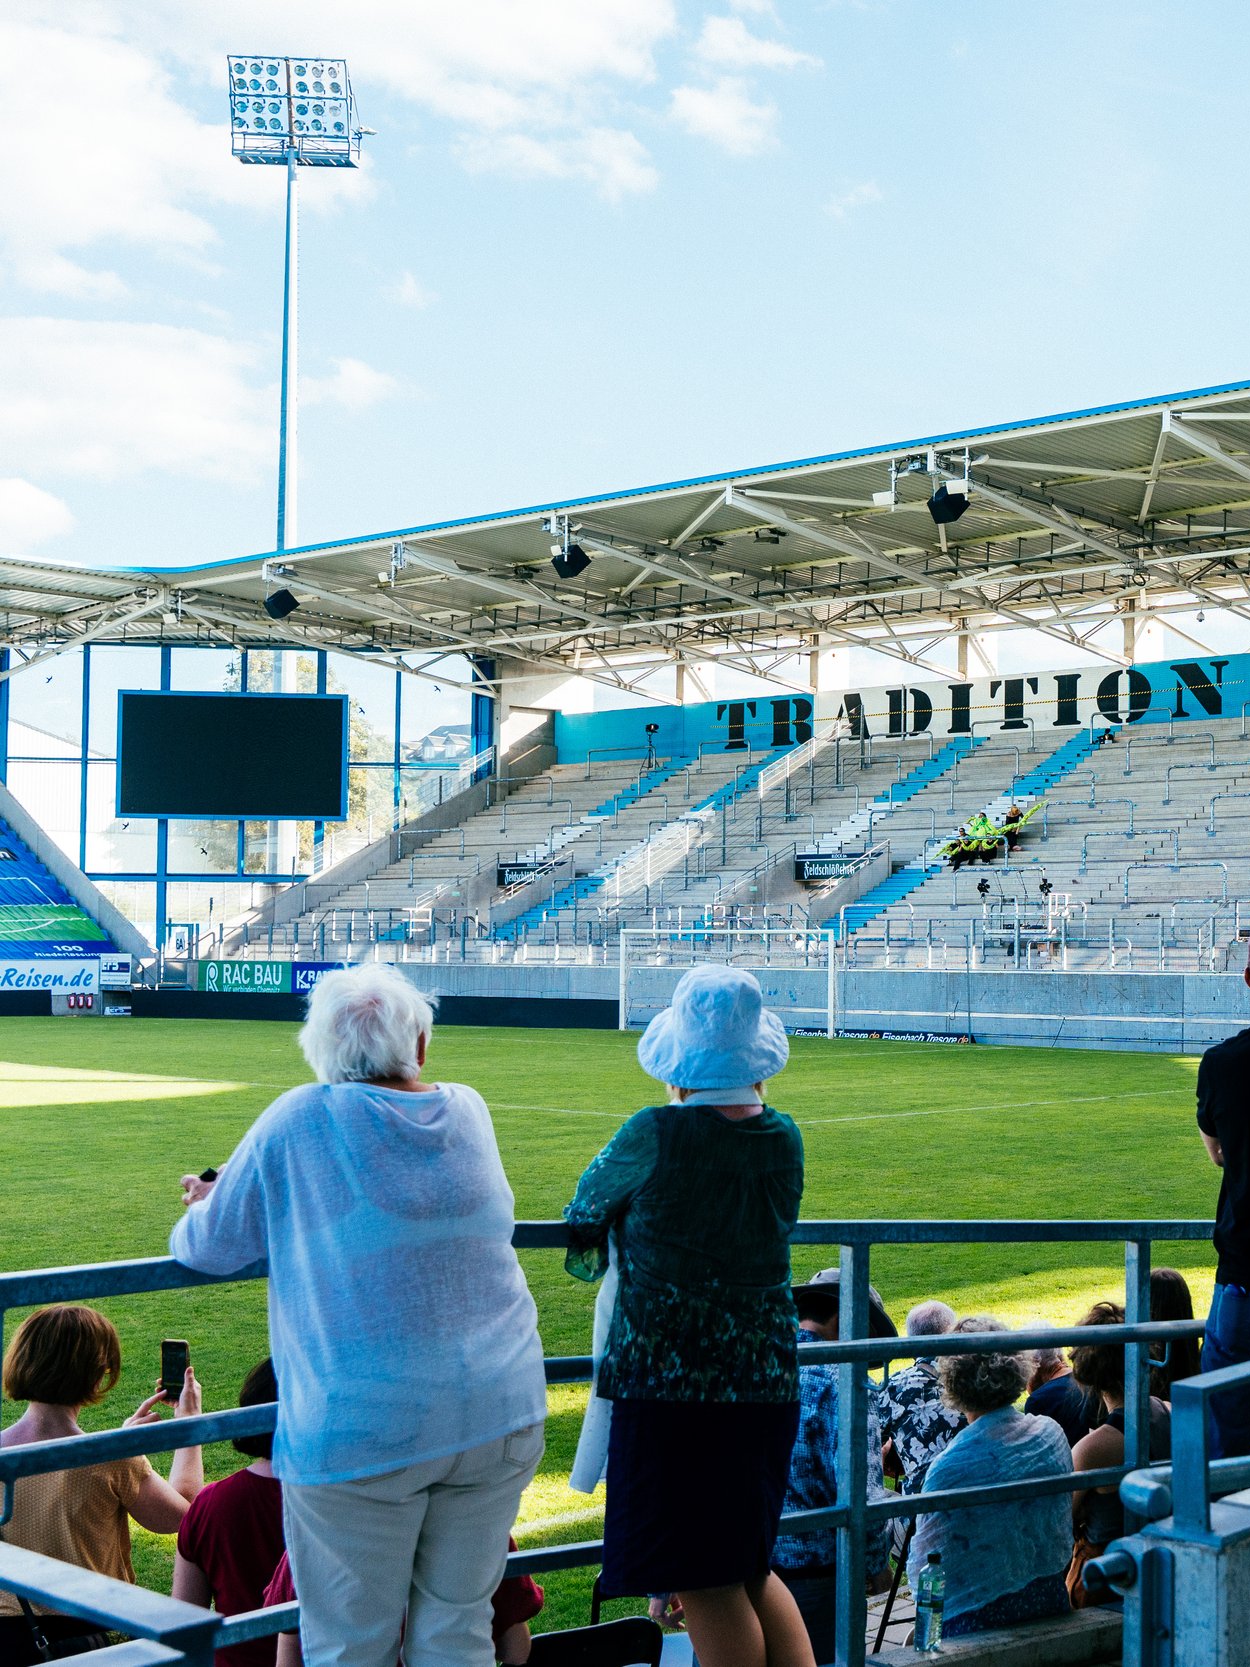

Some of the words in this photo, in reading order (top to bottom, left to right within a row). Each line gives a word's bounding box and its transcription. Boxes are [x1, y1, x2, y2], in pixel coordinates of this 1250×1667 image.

[716, 660, 1230, 750] TRADITION
[0, 967, 94, 988] Reisen.de
[223, 963, 251, 985] RAC
[254, 964, 282, 986] BAU
